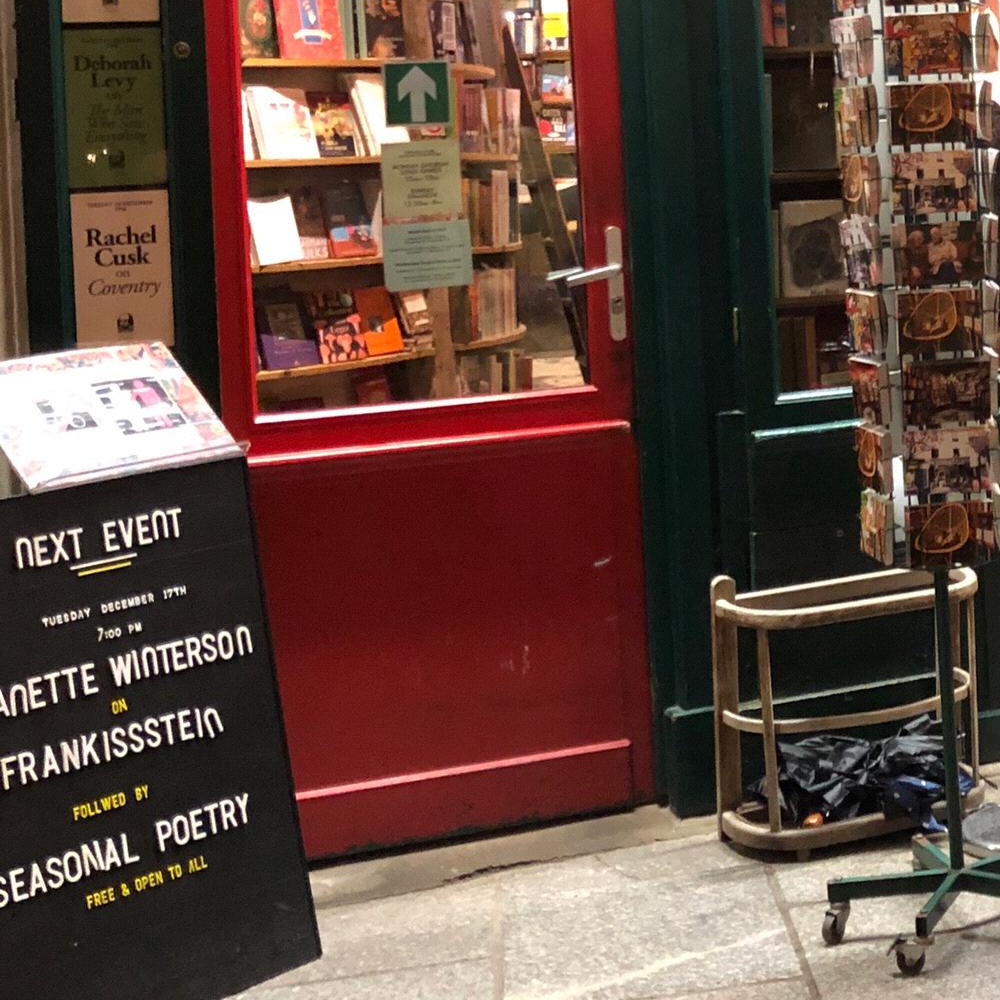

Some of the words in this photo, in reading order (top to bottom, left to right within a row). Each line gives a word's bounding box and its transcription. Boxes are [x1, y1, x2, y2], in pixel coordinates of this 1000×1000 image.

[74, 54, 152, 71] Deborah
[91, 72, 137, 92] Levy
[85, 224, 156, 247] Rachel
[94, 246, 151, 267] Cusk
[87, 279, 162, 298] Coventry
[15, 527, 84, 569] NEXT
[102, 508, 182, 553] EVENT
[41, 607, 92, 628] TUESDAY
[100, 592, 155, 614] DECEMBER
[162, 585, 187, 600] 17TH
[97, 627, 122, 642] 7:00
[128, 622, 143, 633] PM
[109, 626, 254, 687] WINTERSON
[111, 698, 129, 715] ON
[0, 706, 225, 791] FRANKISSSTEIN
[72, 793, 127, 821] FOLLWED
[135, 784, 150, 802] BY
[0, 833, 140, 908] SEASONAL
[155, 793, 249, 852] POETRY
[86, 886, 116, 910] FREE
[121, 882, 131, 897] &
[135, 870, 164, 894] OPEN
[168, 864, 183, 879] TO
[187, 855, 209, 873] ALL
